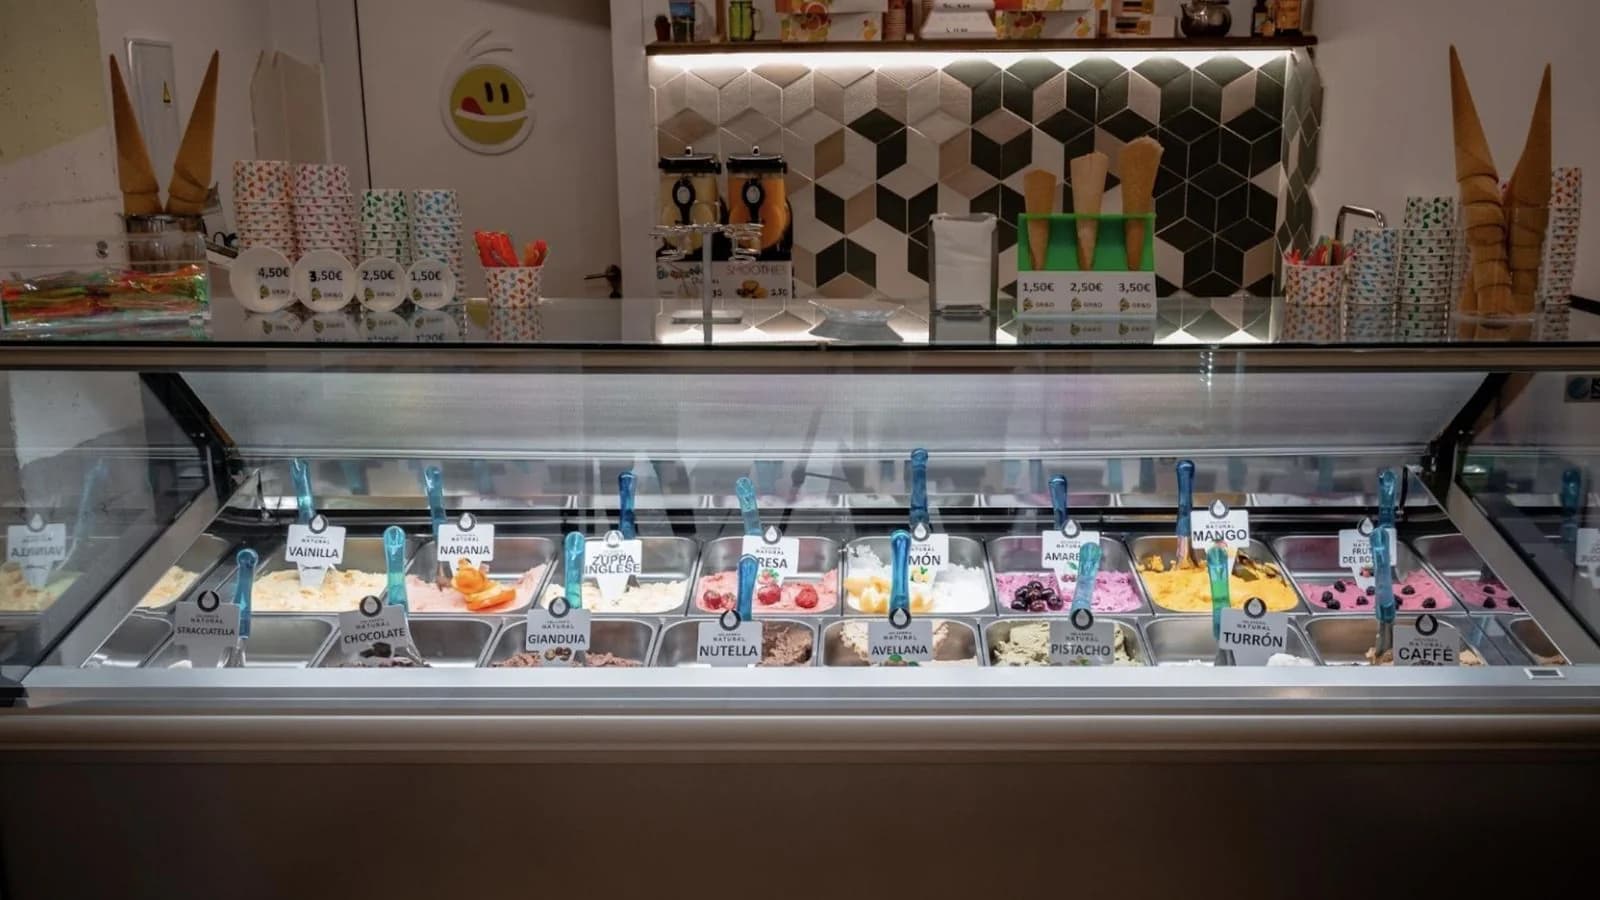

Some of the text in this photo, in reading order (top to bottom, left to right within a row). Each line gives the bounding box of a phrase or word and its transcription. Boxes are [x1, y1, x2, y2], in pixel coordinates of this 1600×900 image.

[258, 267, 289, 279] 4,50€
[309, 270, 343, 282] 3,50€
[362, 270, 395, 281] 2,50€
[411, 271, 442, 281] 1,50€
[1023, 282, 1055, 293] 1,50€
[1070, 282, 1104, 293] 2,50€
[1119, 282, 1152, 293] 3,50€
[1193, 529, 1247, 542] MANGO
[289, 546, 339, 559] VAINILLA
[440, 545, 490, 556] NARANJA
[592, 554, 635, 566] ZUPPA
[909, 552, 941, 566] MÓN
[1045, 552, 1081, 561] AMARE
[1343, 555, 1356, 564] DEL
[757, 557, 788, 568] RESA
[584, 563, 641, 574] INGLESE
[177, 626, 235, 636] STRACCIATELLA
[344, 628, 406, 644] CHOCOLATE
[528, 634, 586, 645] GIANDUIA
[1223, 632, 1283, 648] TURRÓN
[700, 645, 758, 657] NUTELLA
[872, 645, 928, 656] AVELLANA
[1051, 644, 1111, 657] PISTACHO
